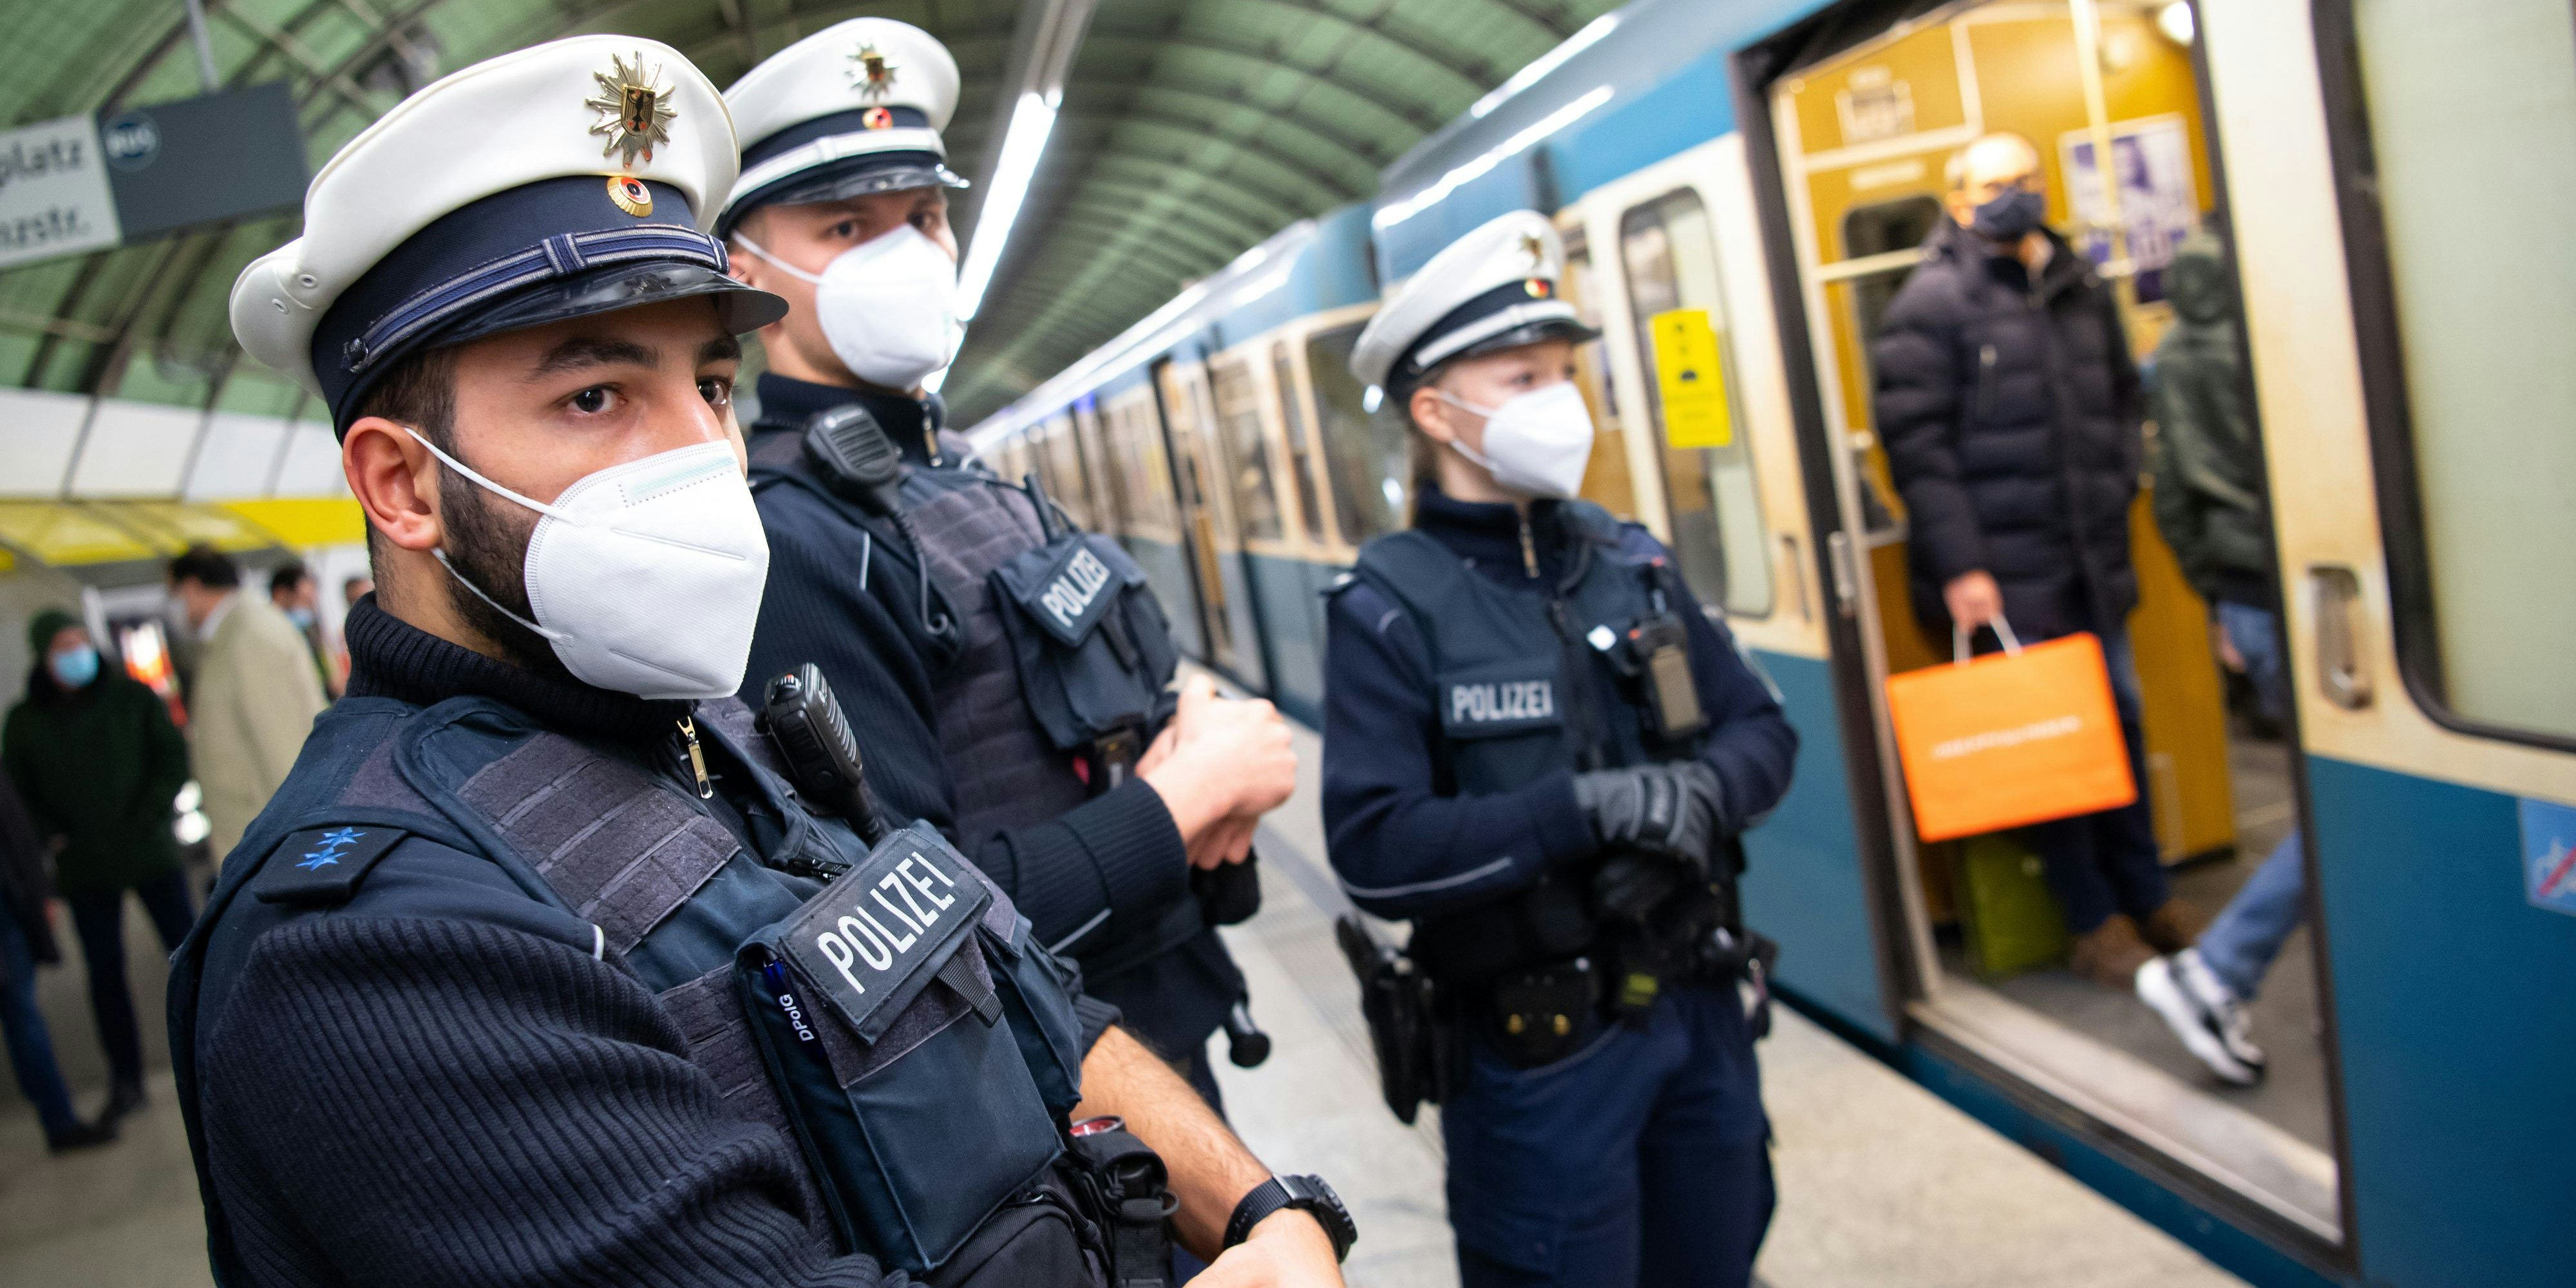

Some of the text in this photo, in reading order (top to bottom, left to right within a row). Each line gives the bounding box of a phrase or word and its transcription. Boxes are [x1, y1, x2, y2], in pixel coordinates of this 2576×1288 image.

[1041, 547, 1111, 628] POLIZEI
[1451, 680, 1554, 723] POLIZEI
[816, 851, 956, 994] POLIZEI
[779, 994, 815, 1042] DPolG
